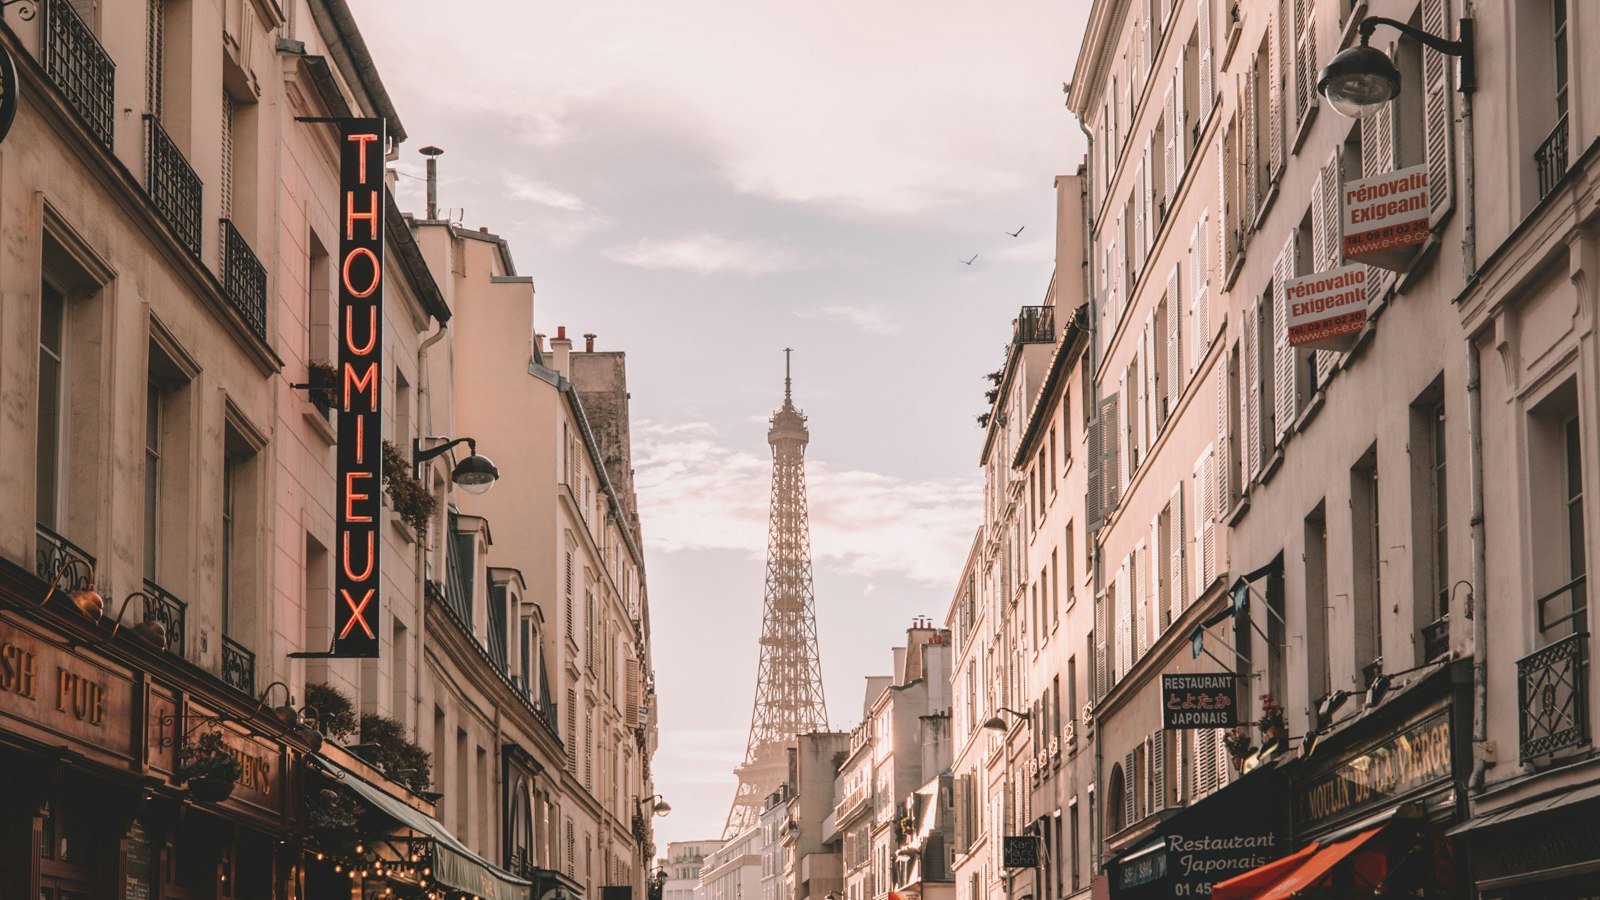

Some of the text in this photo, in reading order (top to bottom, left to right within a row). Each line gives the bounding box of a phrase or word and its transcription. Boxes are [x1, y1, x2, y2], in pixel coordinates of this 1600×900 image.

[1351, 191, 1429, 225] Exigeant
[1367, 230, 1380, 241] 09
[1383, 227, 1394, 238] 81
[1397, 224, 1409, 235] 02
[1286, 270, 1365, 301] rénovatio
[339, 133, 381, 640] THOUMIEUX
[1164, 676, 1232, 690] RESTAURANT
[1167, 692, 1231, 710] とよたか
[1171, 711, 1228, 725] JAPONAIS
[1308, 768, 1350, 821] MOULIN
[1354, 758, 1371, 804] DE
[1395, 721, 1451, 785] VIERGE
[1010, 839, 1034, 848] Karl
[1168, 832, 1276, 852] Restaurant
[1005, 847, 1033, 857] Marc
[1006, 856, 1035, 865] John
[1180, 853, 1267, 877] Japonais
[1175, 881, 1212, 896] 01 45
